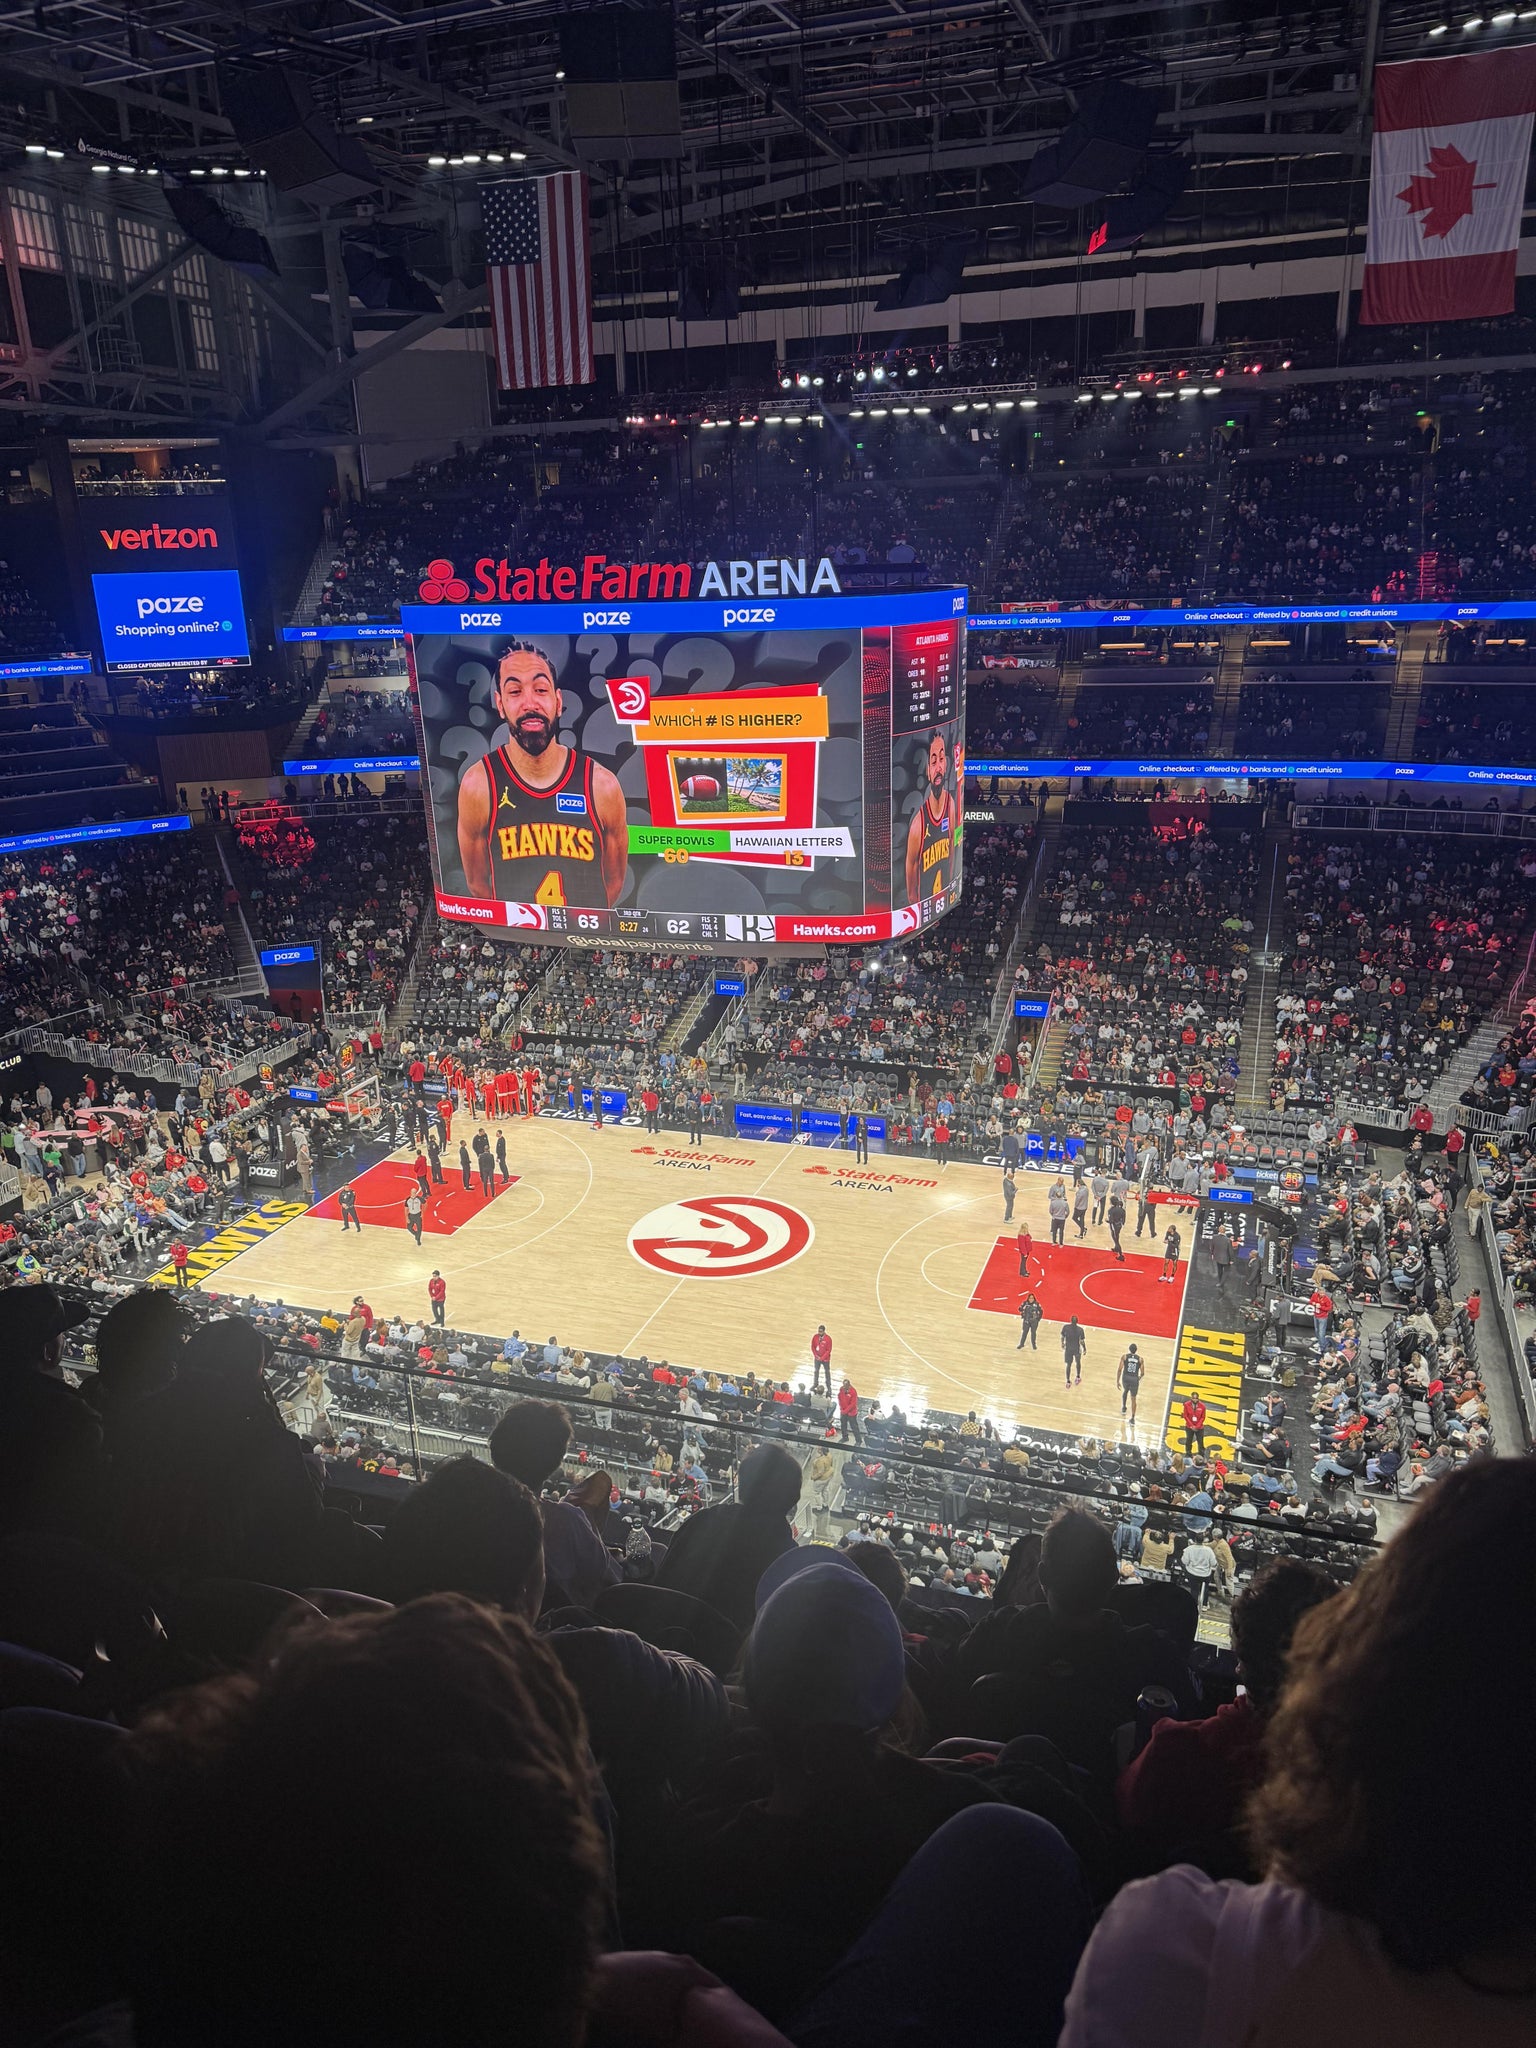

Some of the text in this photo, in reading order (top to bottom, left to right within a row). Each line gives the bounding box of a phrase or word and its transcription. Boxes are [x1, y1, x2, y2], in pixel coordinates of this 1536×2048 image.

[86, 144, 107, 157] Georgia
[107, 149, 127, 161] Natural
[100, 524, 218, 550] verizon
[699, 558, 842, 597] ARENA
[137, 596, 204, 619] paze
[952, 596, 964, 614] paze
[724, 608, 777, 627] paze
[1184, 613, 1208, 621] Online
[1210, 612, 1243, 620] checkout
[1281, 612, 1290, 620] by
[1300, 610, 1323, 618] banks
[1349, 608, 1371, 616] credit
[1372, 608, 1398, 616] unions
[1458, 608, 1479, 616] paze
[460, 612, 502, 630] paze
[583, 611, 631, 629] paze
[976, 618, 997, 626] banks
[1019, 616, 1038, 624] credit
[1039, 616, 1062, 624] unions
[115, 621, 220, 637] Shopping online?
[916, 634, 936, 646] ATLANTA
[117, 662, 138, 670] CLOSED
[138, 661, 171, 669] CAPTIONING
[172, 660, 200, 668] PRESENTED
[654, 713, 802, 727] WHICH # IS HIGHER?
[988, 764, 1007, 772] credit
[1008, 764, 1029, 772] unions
[1204, 766, 1230, 774] offered
[1231, 766, 1240, 774] by
[1250, 766, 1271, 774] banks
[1272, 766, 1287, 774] and
[1296, 766, 1317, 774] credit
[1318, 766, 1343, 774] unions
[1468, 770, 1532, 781] Online checkout
[559, 798, 584, 808] paze
[964, 811, 995, 821] ARENA
[152, 822, 169, 830] paze
[42, 836, 49, 844] by
[55, 832, 71, 840] banks
[497, 822, 595, 862] HAWKS
[638, 835, 714, 846] SUPER BOWLS
[735, 837, 843, 847] HAWAIIAN LETTERS
[664, 848, 689, 864] 60
[784, 850, 805, 866] 13
[922, 838, 950, 872] HAWKS
[535, 870, 567, 907] 4
[932, 870, 942, 894] 4
[439, 900, 493, 919] Hawks.com
[936, 898, 945, 913] 63
[552, 914, 562, 922] TOL
[577, 914, 600, 930] 63
[620, 921, 638, 932] 8:27
[666, 920, 690, 934] 62
[793, 922, 876, 936] Hawks.com
[702, 930, 712, 938] CHL
[274, 952, 301, 962] paze
[1020, 1004, 1043, 1012] paze
[0, 1055, 22, 1070] CLUB
[582, 1093, 614, 1105] pze
[766, 1114, 784, 1122] online
[654, 1159, 712, 1171] ARENA
[248, 1166, 278, 1178] paze
[830, 1179, 893, 1192] ARENA
[1218, 1190, 1243, 1200] paze
[146, 1200, 310, 1288] HAWKS
